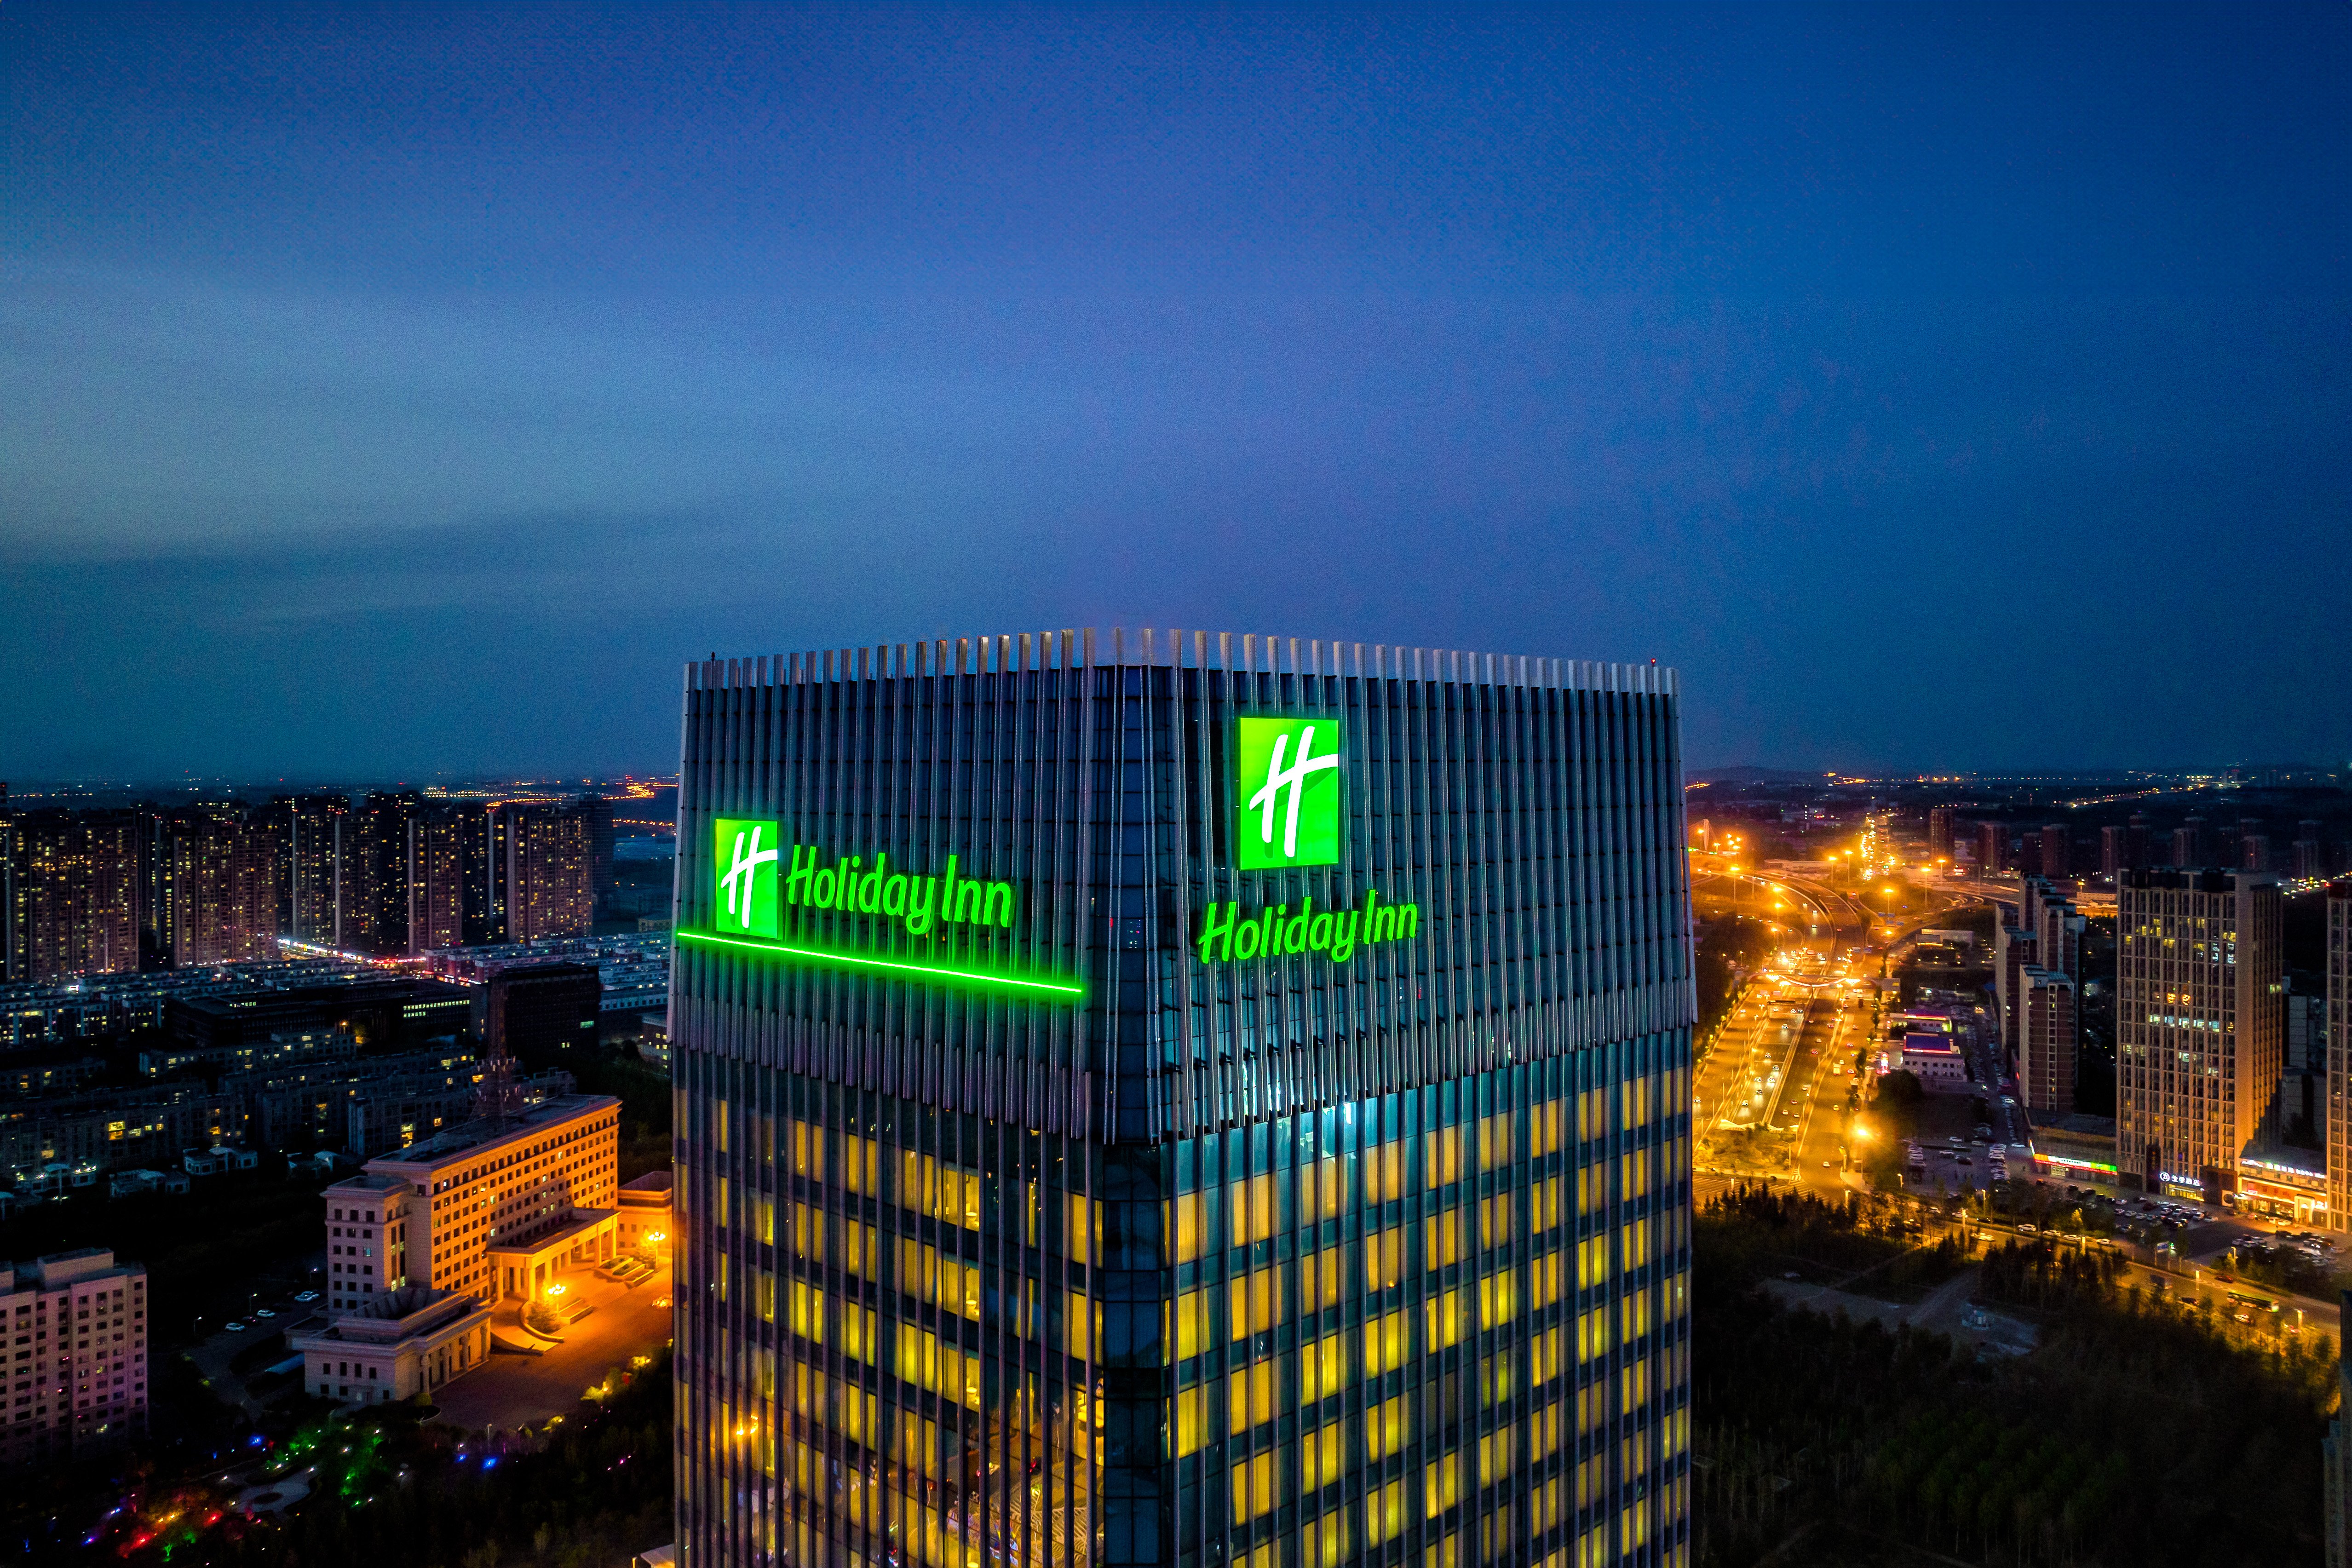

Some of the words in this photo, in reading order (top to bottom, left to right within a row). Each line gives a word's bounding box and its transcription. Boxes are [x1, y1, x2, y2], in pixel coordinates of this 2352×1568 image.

[786, 844, 936, 935] Holiday
[942, 854, 1012, 928] Inn
[1198, 896, 1358, 964] Holiday
[1363, 889, 1418, 945] Inn
